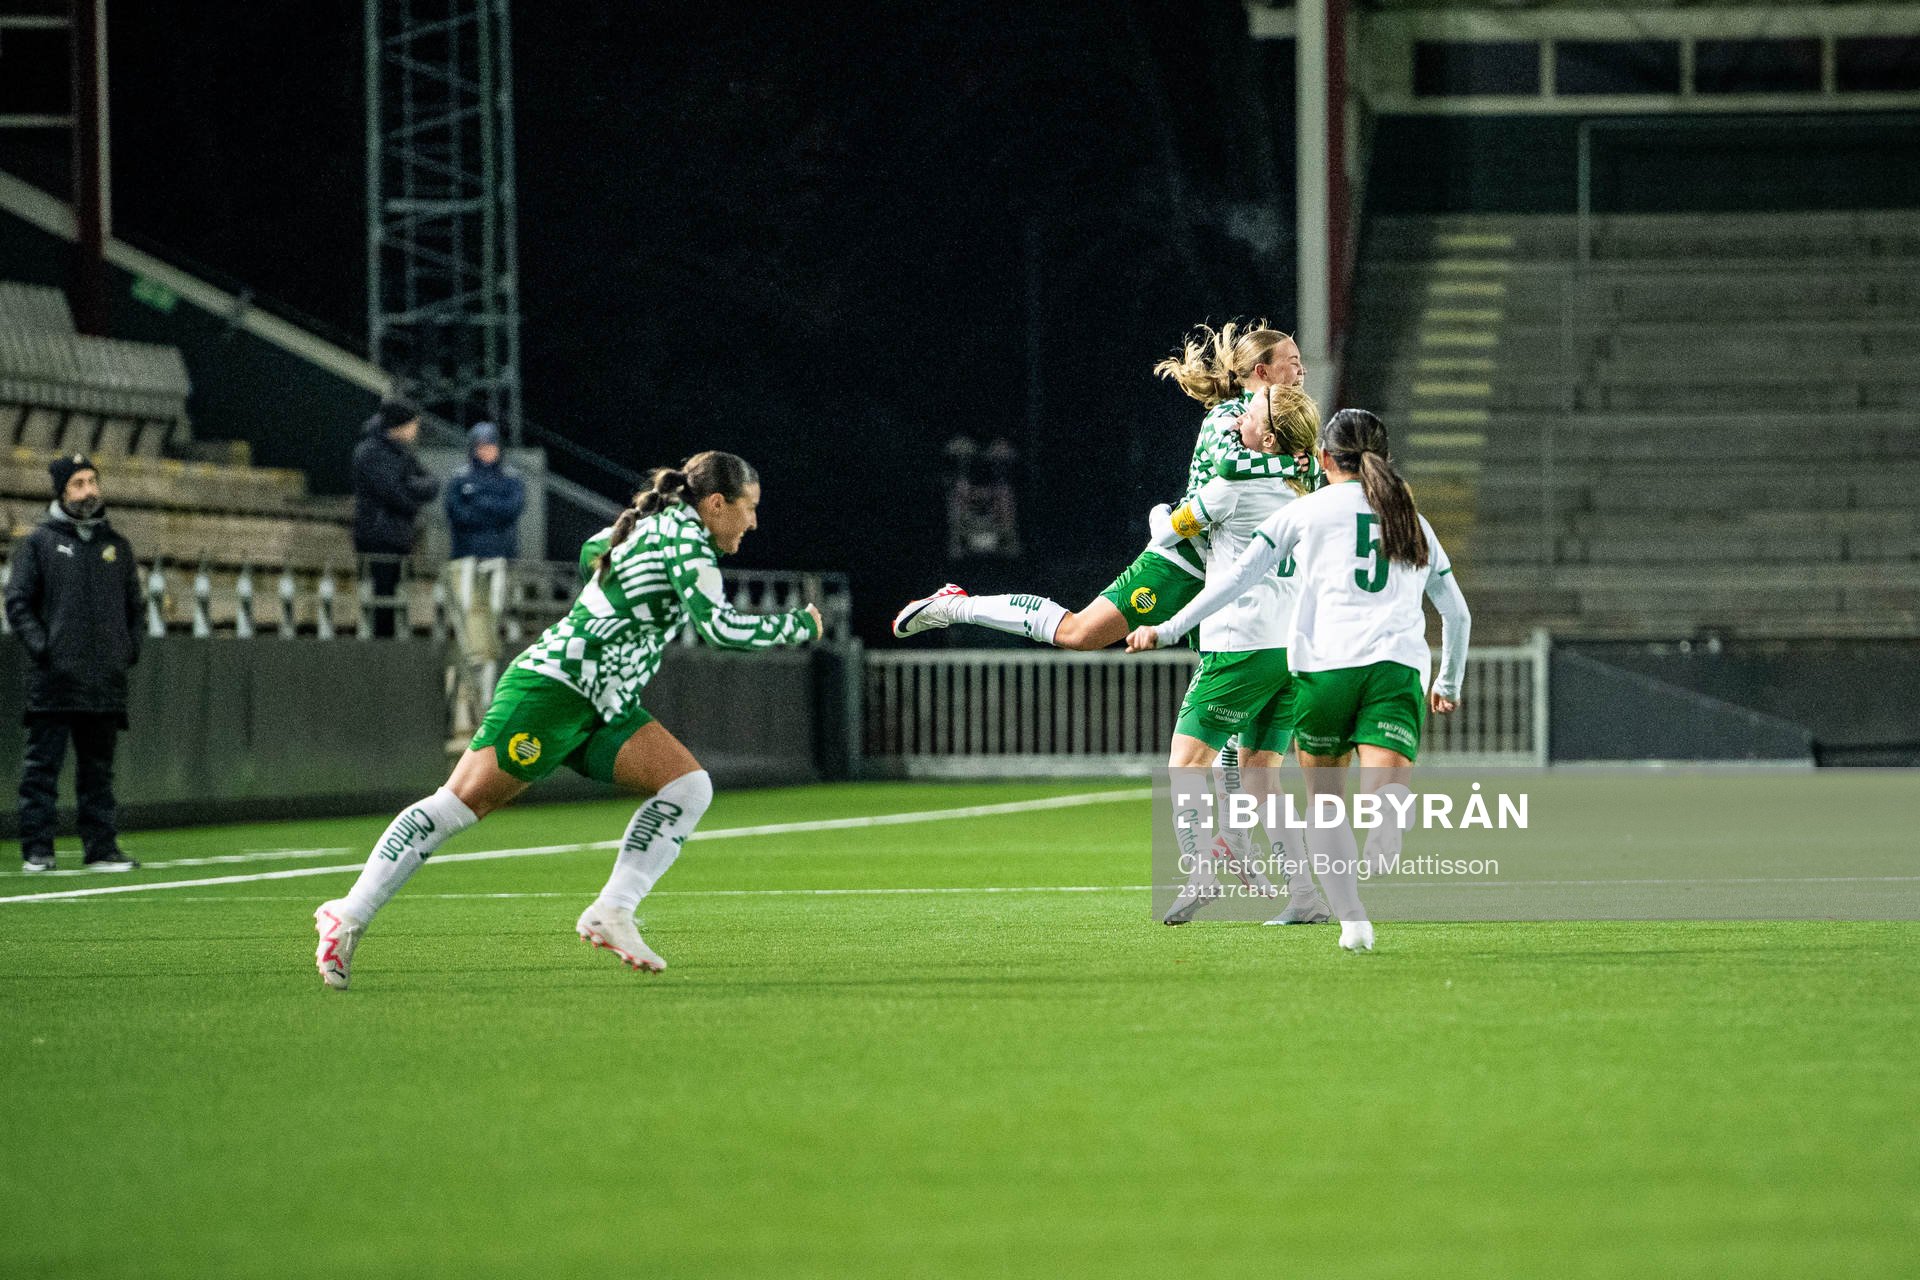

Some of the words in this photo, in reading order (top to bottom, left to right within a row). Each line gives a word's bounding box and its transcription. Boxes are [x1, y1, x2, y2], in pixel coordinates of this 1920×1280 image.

[1354, 512, 1390, 593] 5
[1009, 593, 1043, 615] nton
[378, 808, 436, 862] Clinton
[624, 800, 683, 852] Clinton
